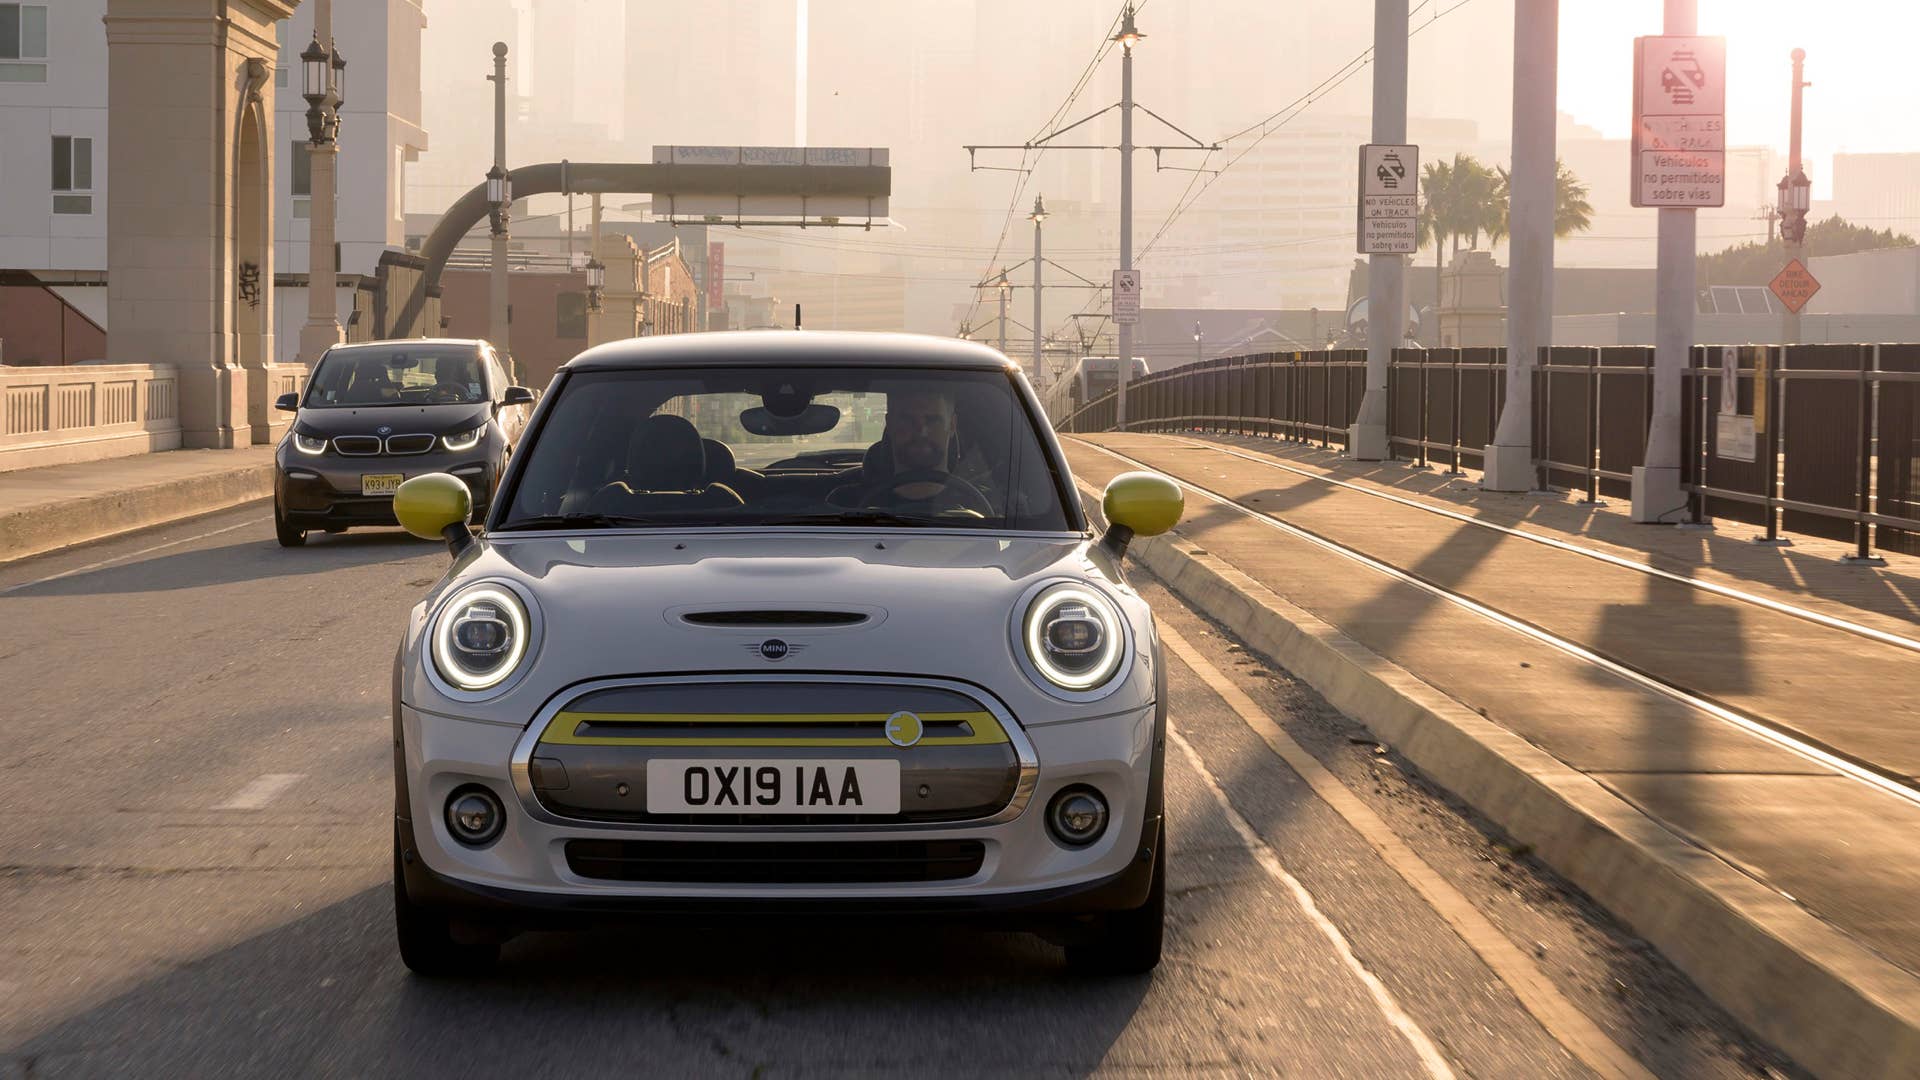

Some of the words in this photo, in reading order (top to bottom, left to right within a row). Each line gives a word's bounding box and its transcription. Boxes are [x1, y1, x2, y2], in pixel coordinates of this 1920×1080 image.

[1643, 174, 1657, 184] no
[1661, 171, 1721, 186] permitidos
[1652, 188, 1685, 200] sobre
[1366, 198, 1376, 206] NO
[1379, 198, 1415, 206] VEHICLES
[1371, 208, 1382, 216] ON
[1384, 208, 1409, 216] TRACK
[1377, 230, 1415, 240] permitidos
[1372, 241, 1392, 249] sobre
[1779, 280, 1810, 289] DETOUR
[684, 766, 781, 806] OX19
